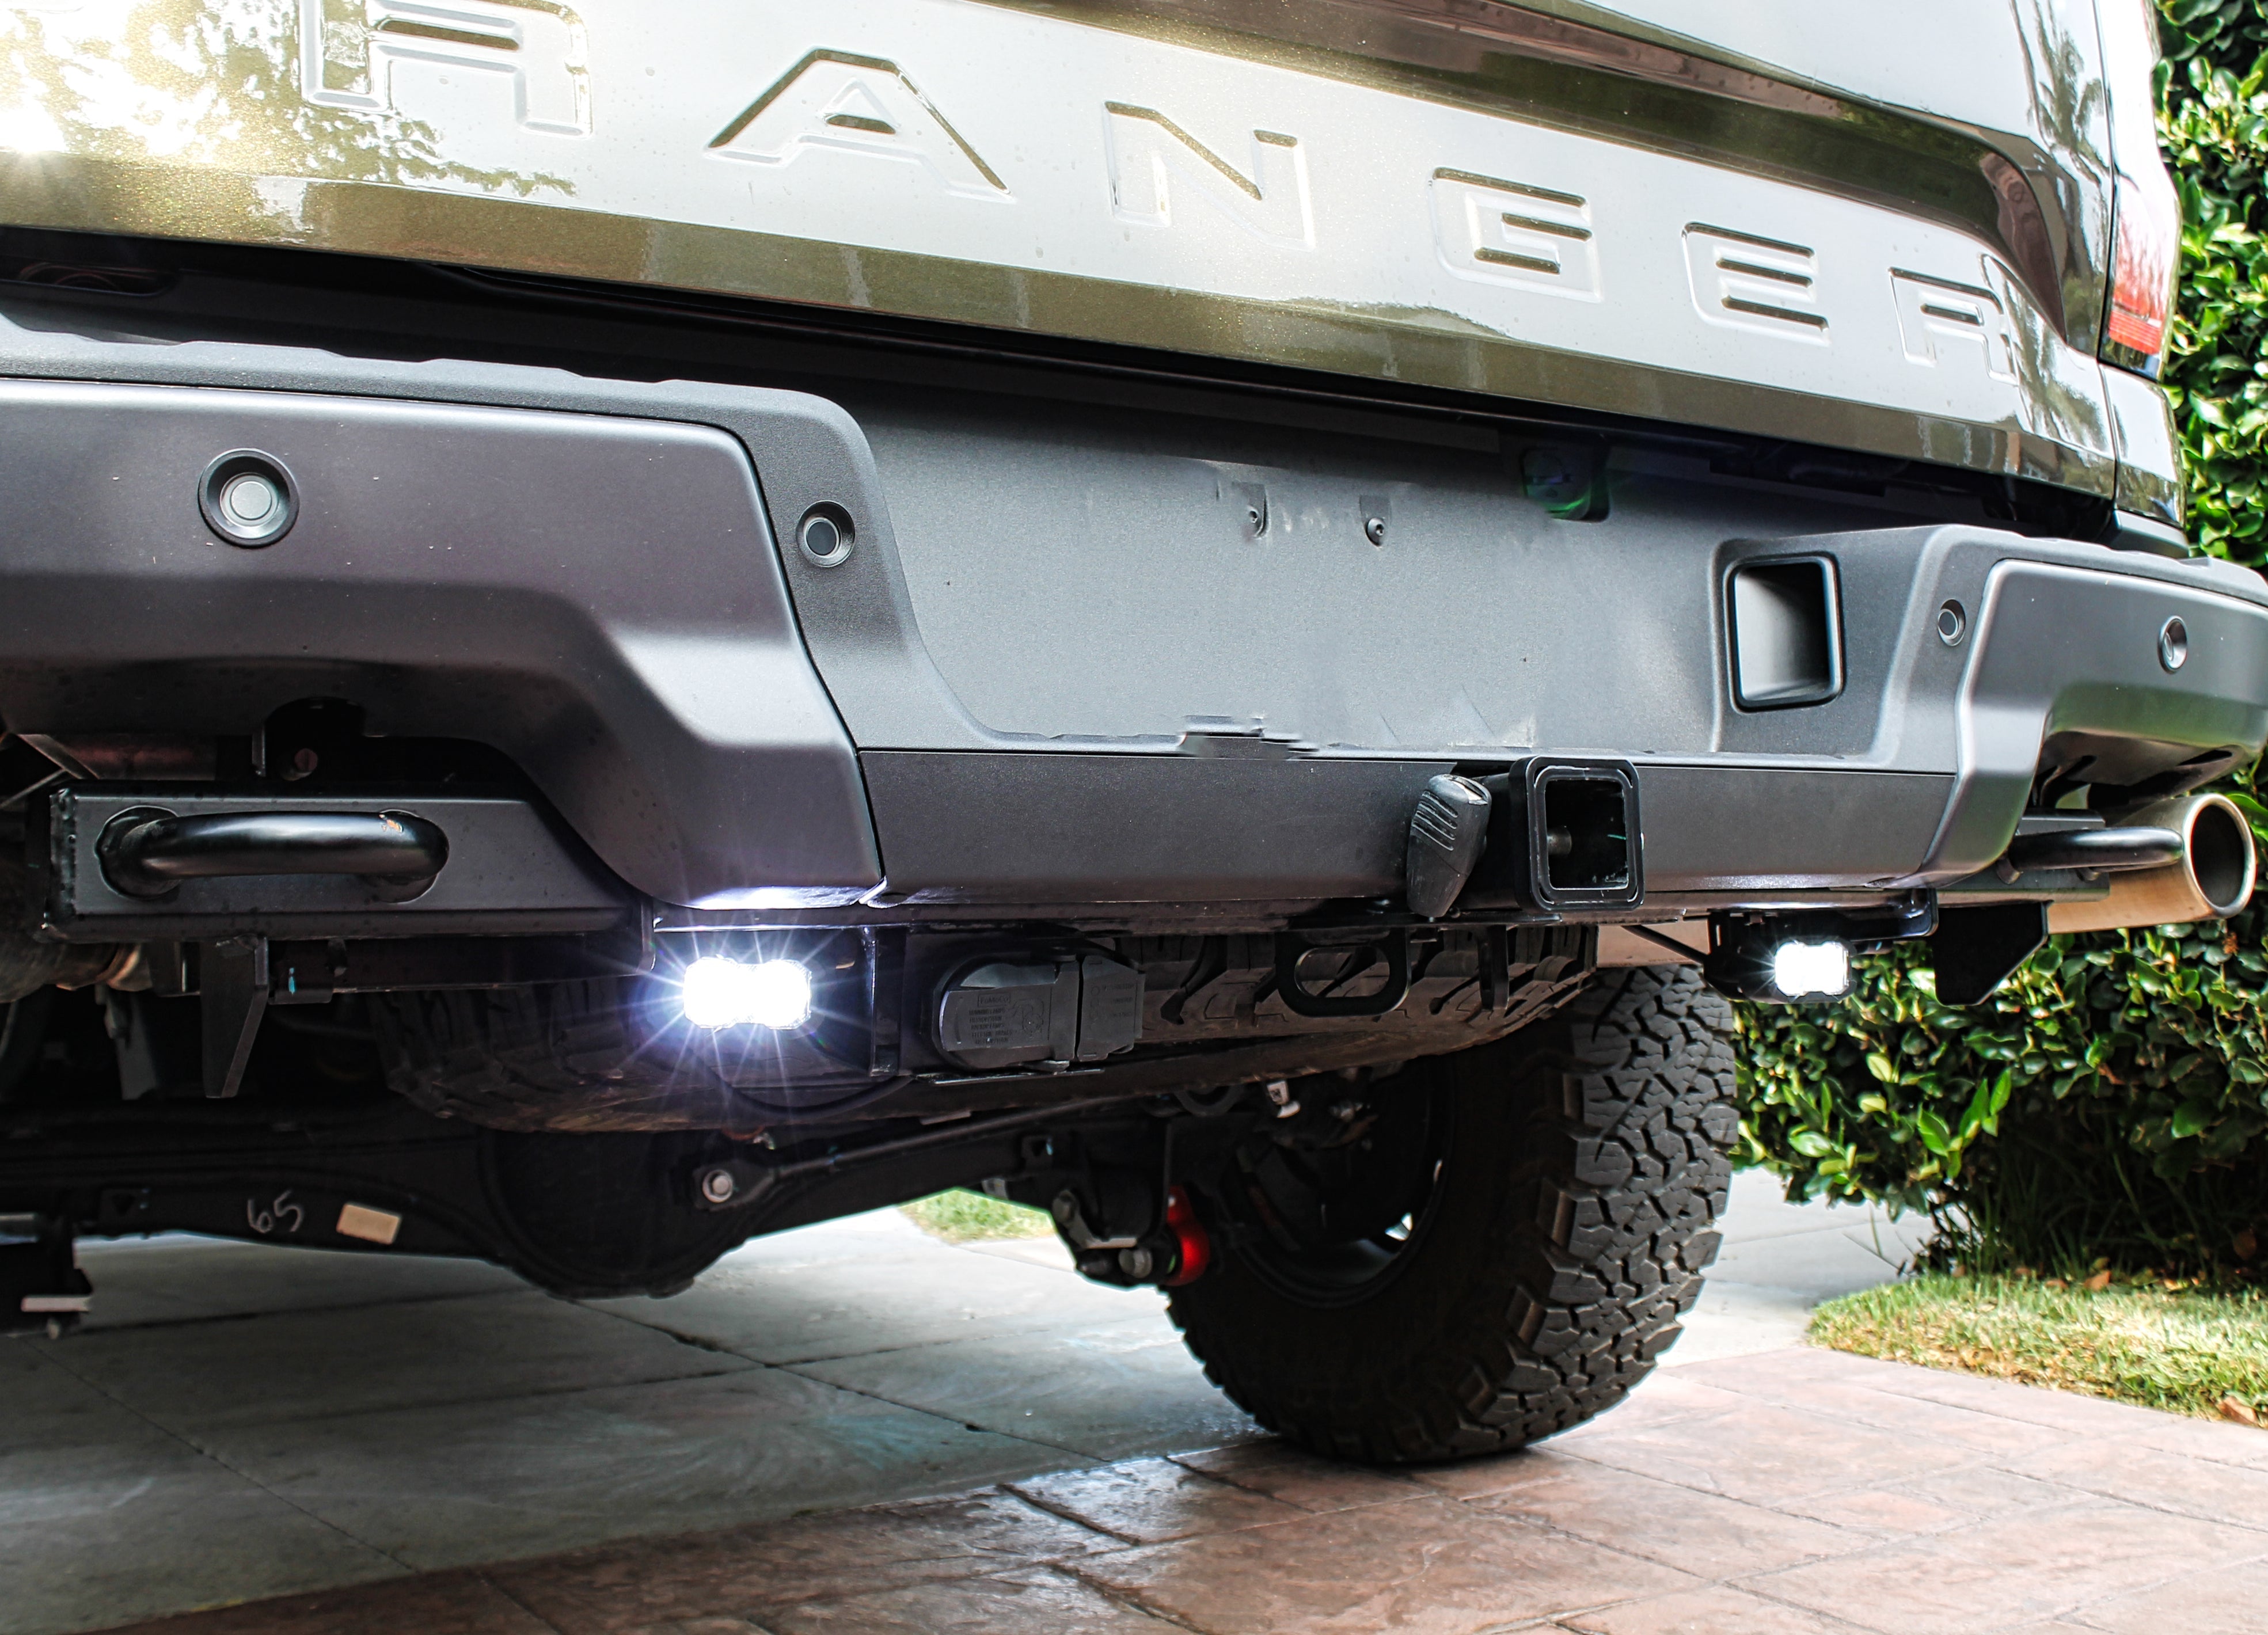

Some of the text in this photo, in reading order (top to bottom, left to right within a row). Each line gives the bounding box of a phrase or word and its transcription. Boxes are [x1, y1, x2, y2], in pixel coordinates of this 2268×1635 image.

[299, 0, 2019, 386] RANGER
[981, 996, 1009, 1004] FoMoCo
[247, 1189, 303, 1233] 65
